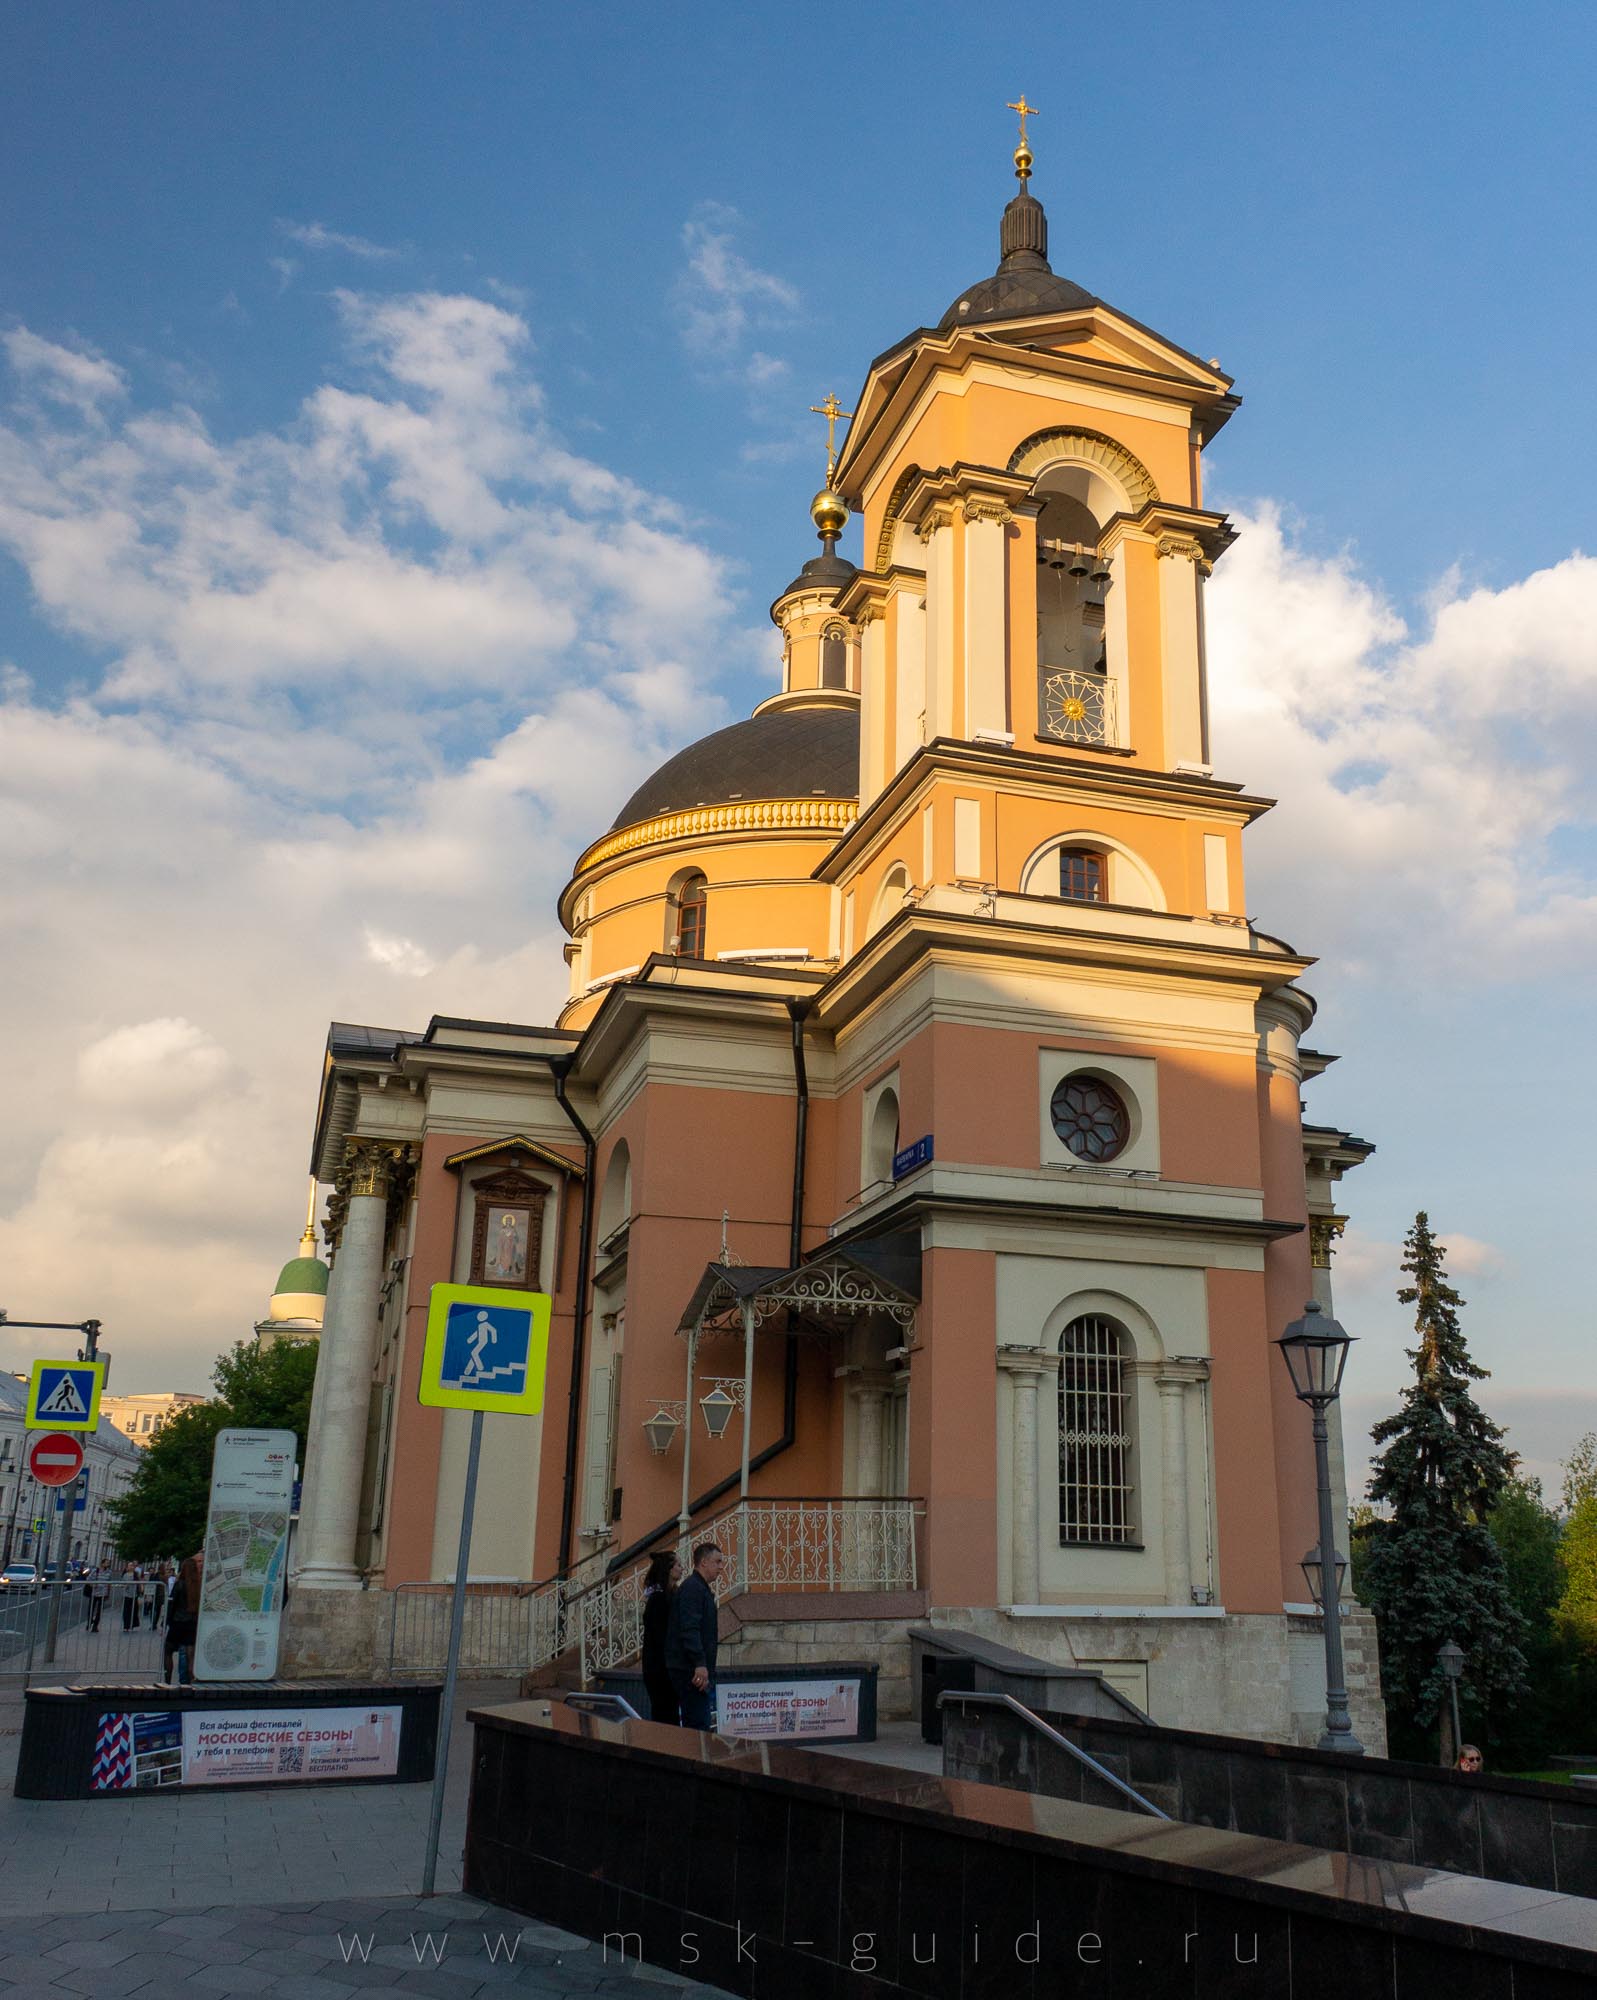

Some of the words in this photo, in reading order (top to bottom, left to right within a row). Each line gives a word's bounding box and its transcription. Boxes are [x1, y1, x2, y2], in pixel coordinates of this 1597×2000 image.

[726, 1699, 789, 1710] МОСКОВСКИЕ
[791, 1698, 828, 1708] СЕЗОНЫ
[199, 1721, 215, 1730] Вся
[217, 1721, 248, 1731] афиша
[249, 1719, 302, 1730] фестивалей
[198, 1732, 294, 1745] МОСКОВСКИЕ
[296, 1730, 353, 1742] СЕЗОНЫ
[196, 1750, 202, 1758] у
[203, 1747, 224, 1756] тебя
[233, 1745, 275, 1755] телефоне
[308, 1764, 349, 1773] БЕСПЛАТНО
